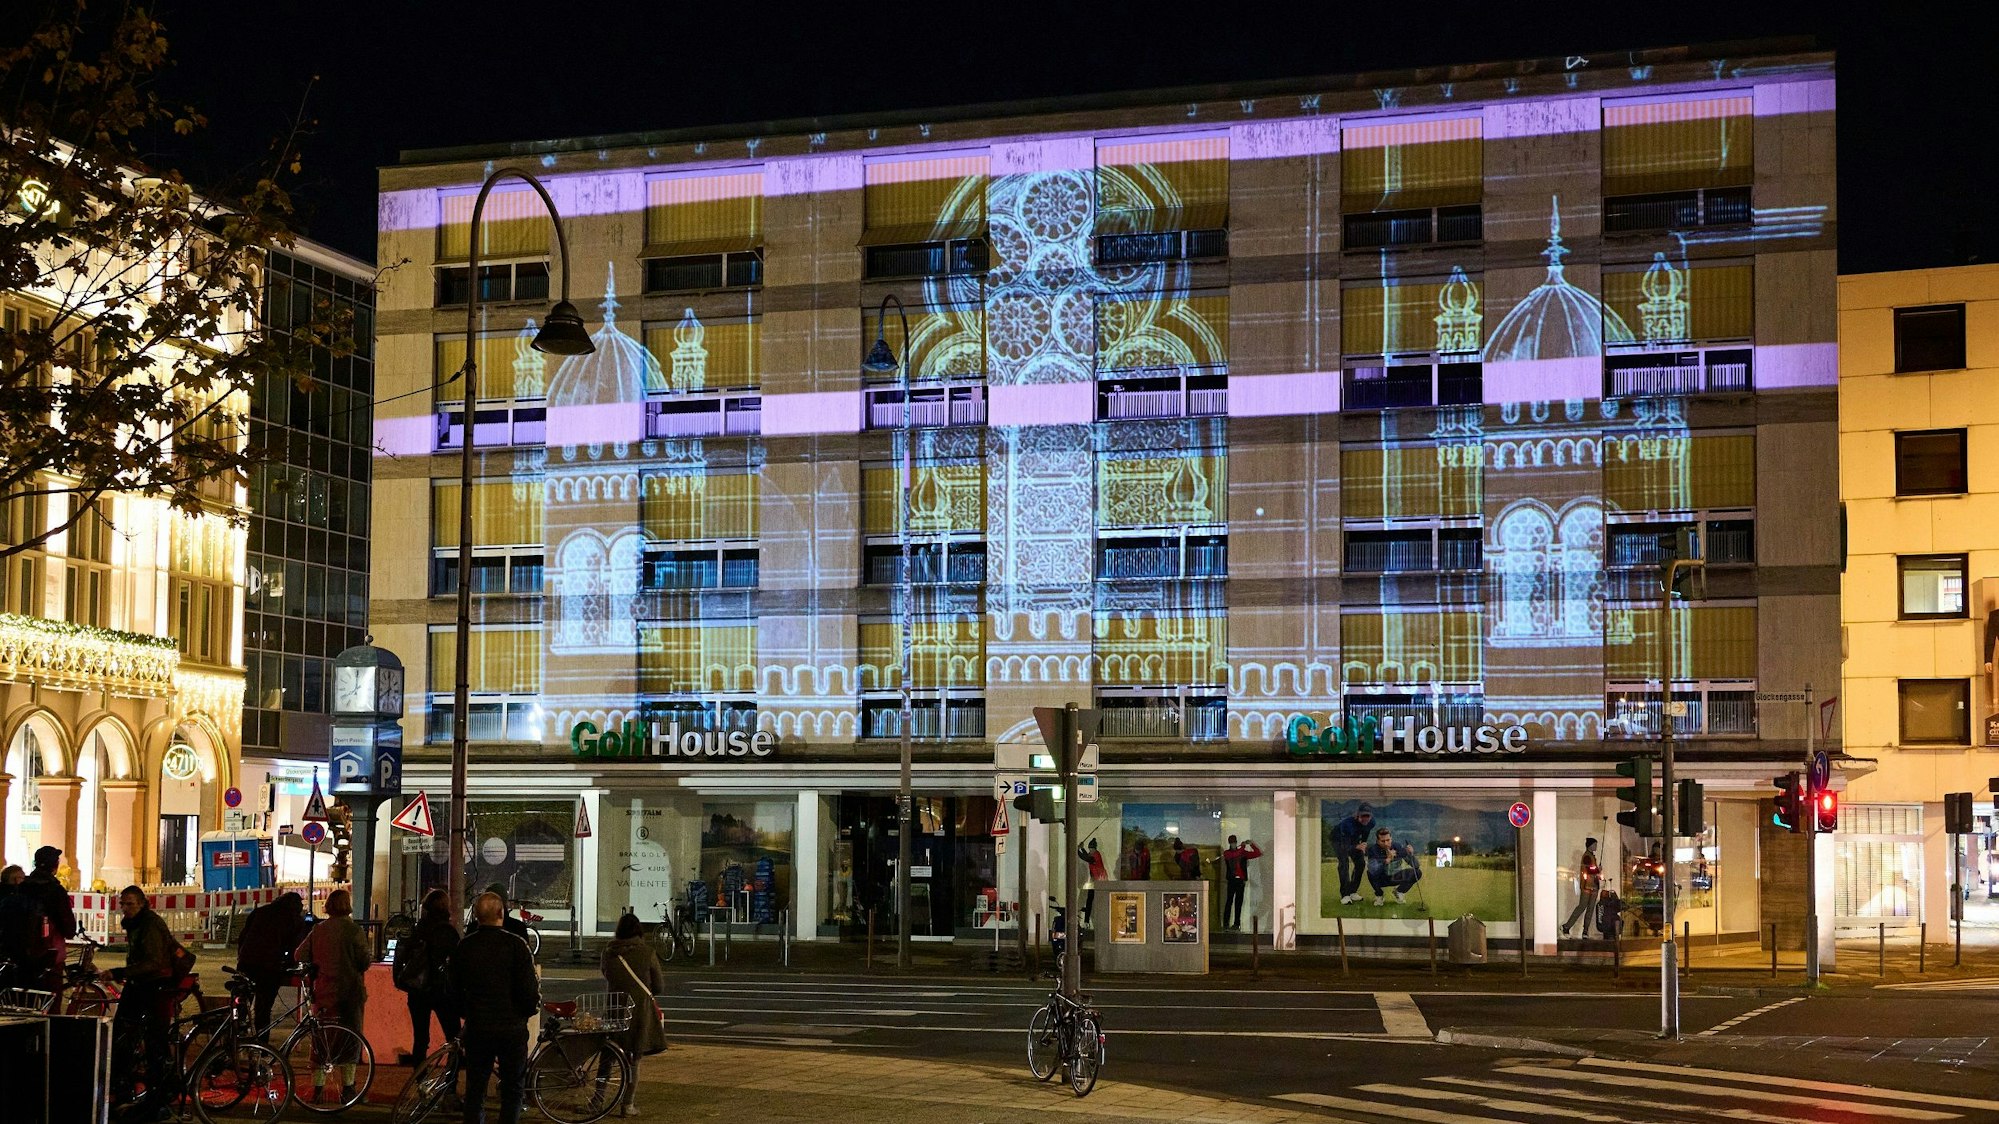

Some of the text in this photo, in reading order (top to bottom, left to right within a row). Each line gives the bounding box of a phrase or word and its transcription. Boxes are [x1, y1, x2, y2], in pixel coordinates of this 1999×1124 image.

[1756, 693, 1805, 702] Glockengasse
[571, 721, 775, 757] Golf House
[1287, 715, 1529, 754] Golf House
[166, 753, 194, 771] 4711
[340, 759, 359, 783] P
[617, 880, 668, 888] VALIENTE
